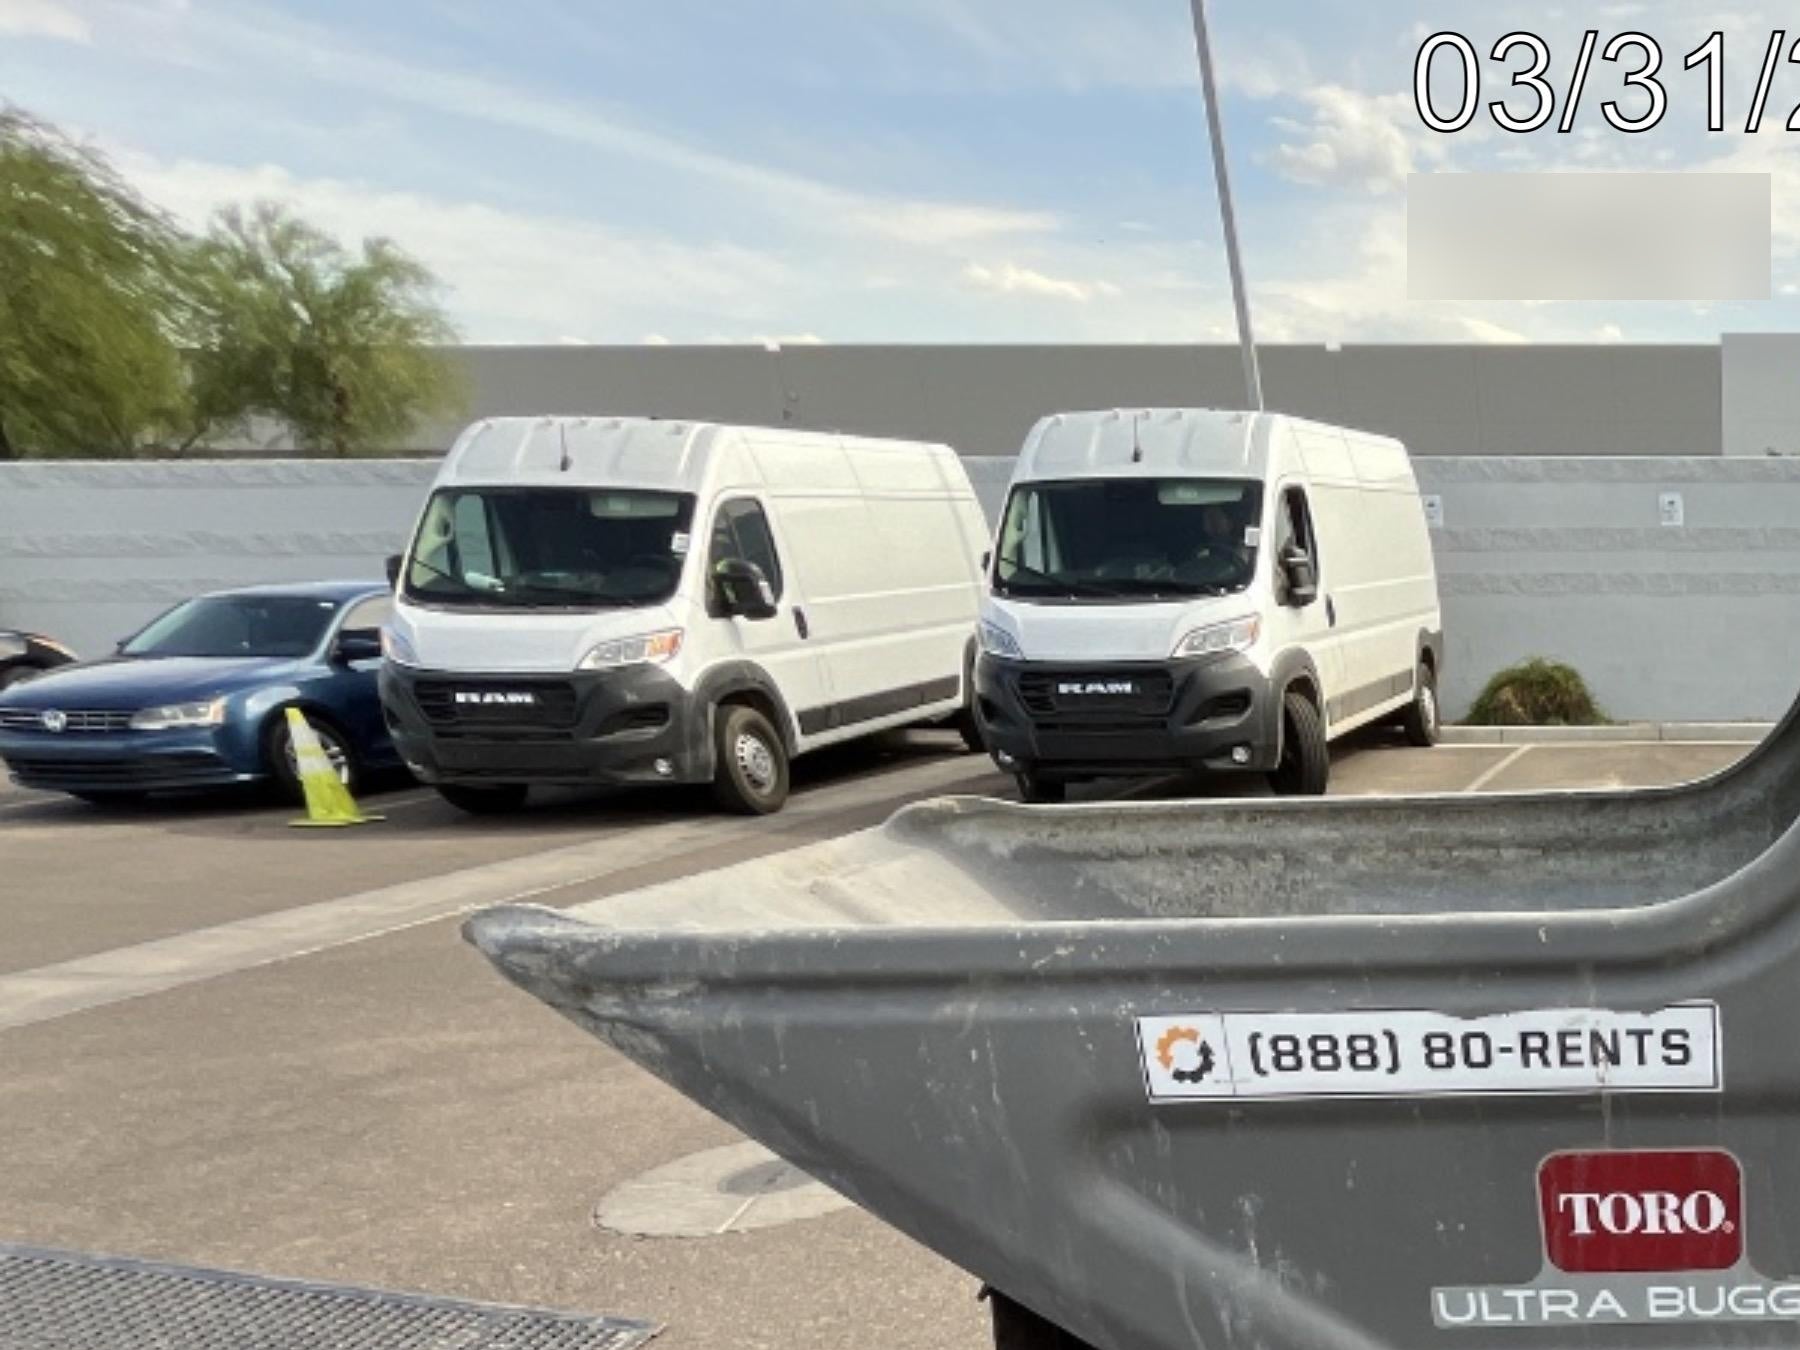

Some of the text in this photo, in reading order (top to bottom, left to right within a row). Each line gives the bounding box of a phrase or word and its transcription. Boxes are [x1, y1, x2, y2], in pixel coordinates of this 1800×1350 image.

[455, 692, 534, 703] RAM
[1058, 682, 1132, 694] RAM
[1248, 1028, 1692, 1076] (888) 80-RENTS
[1559, 1190, 1728, 1237] TORO
[1436, 1289, 1628, 1324] ULTRA
